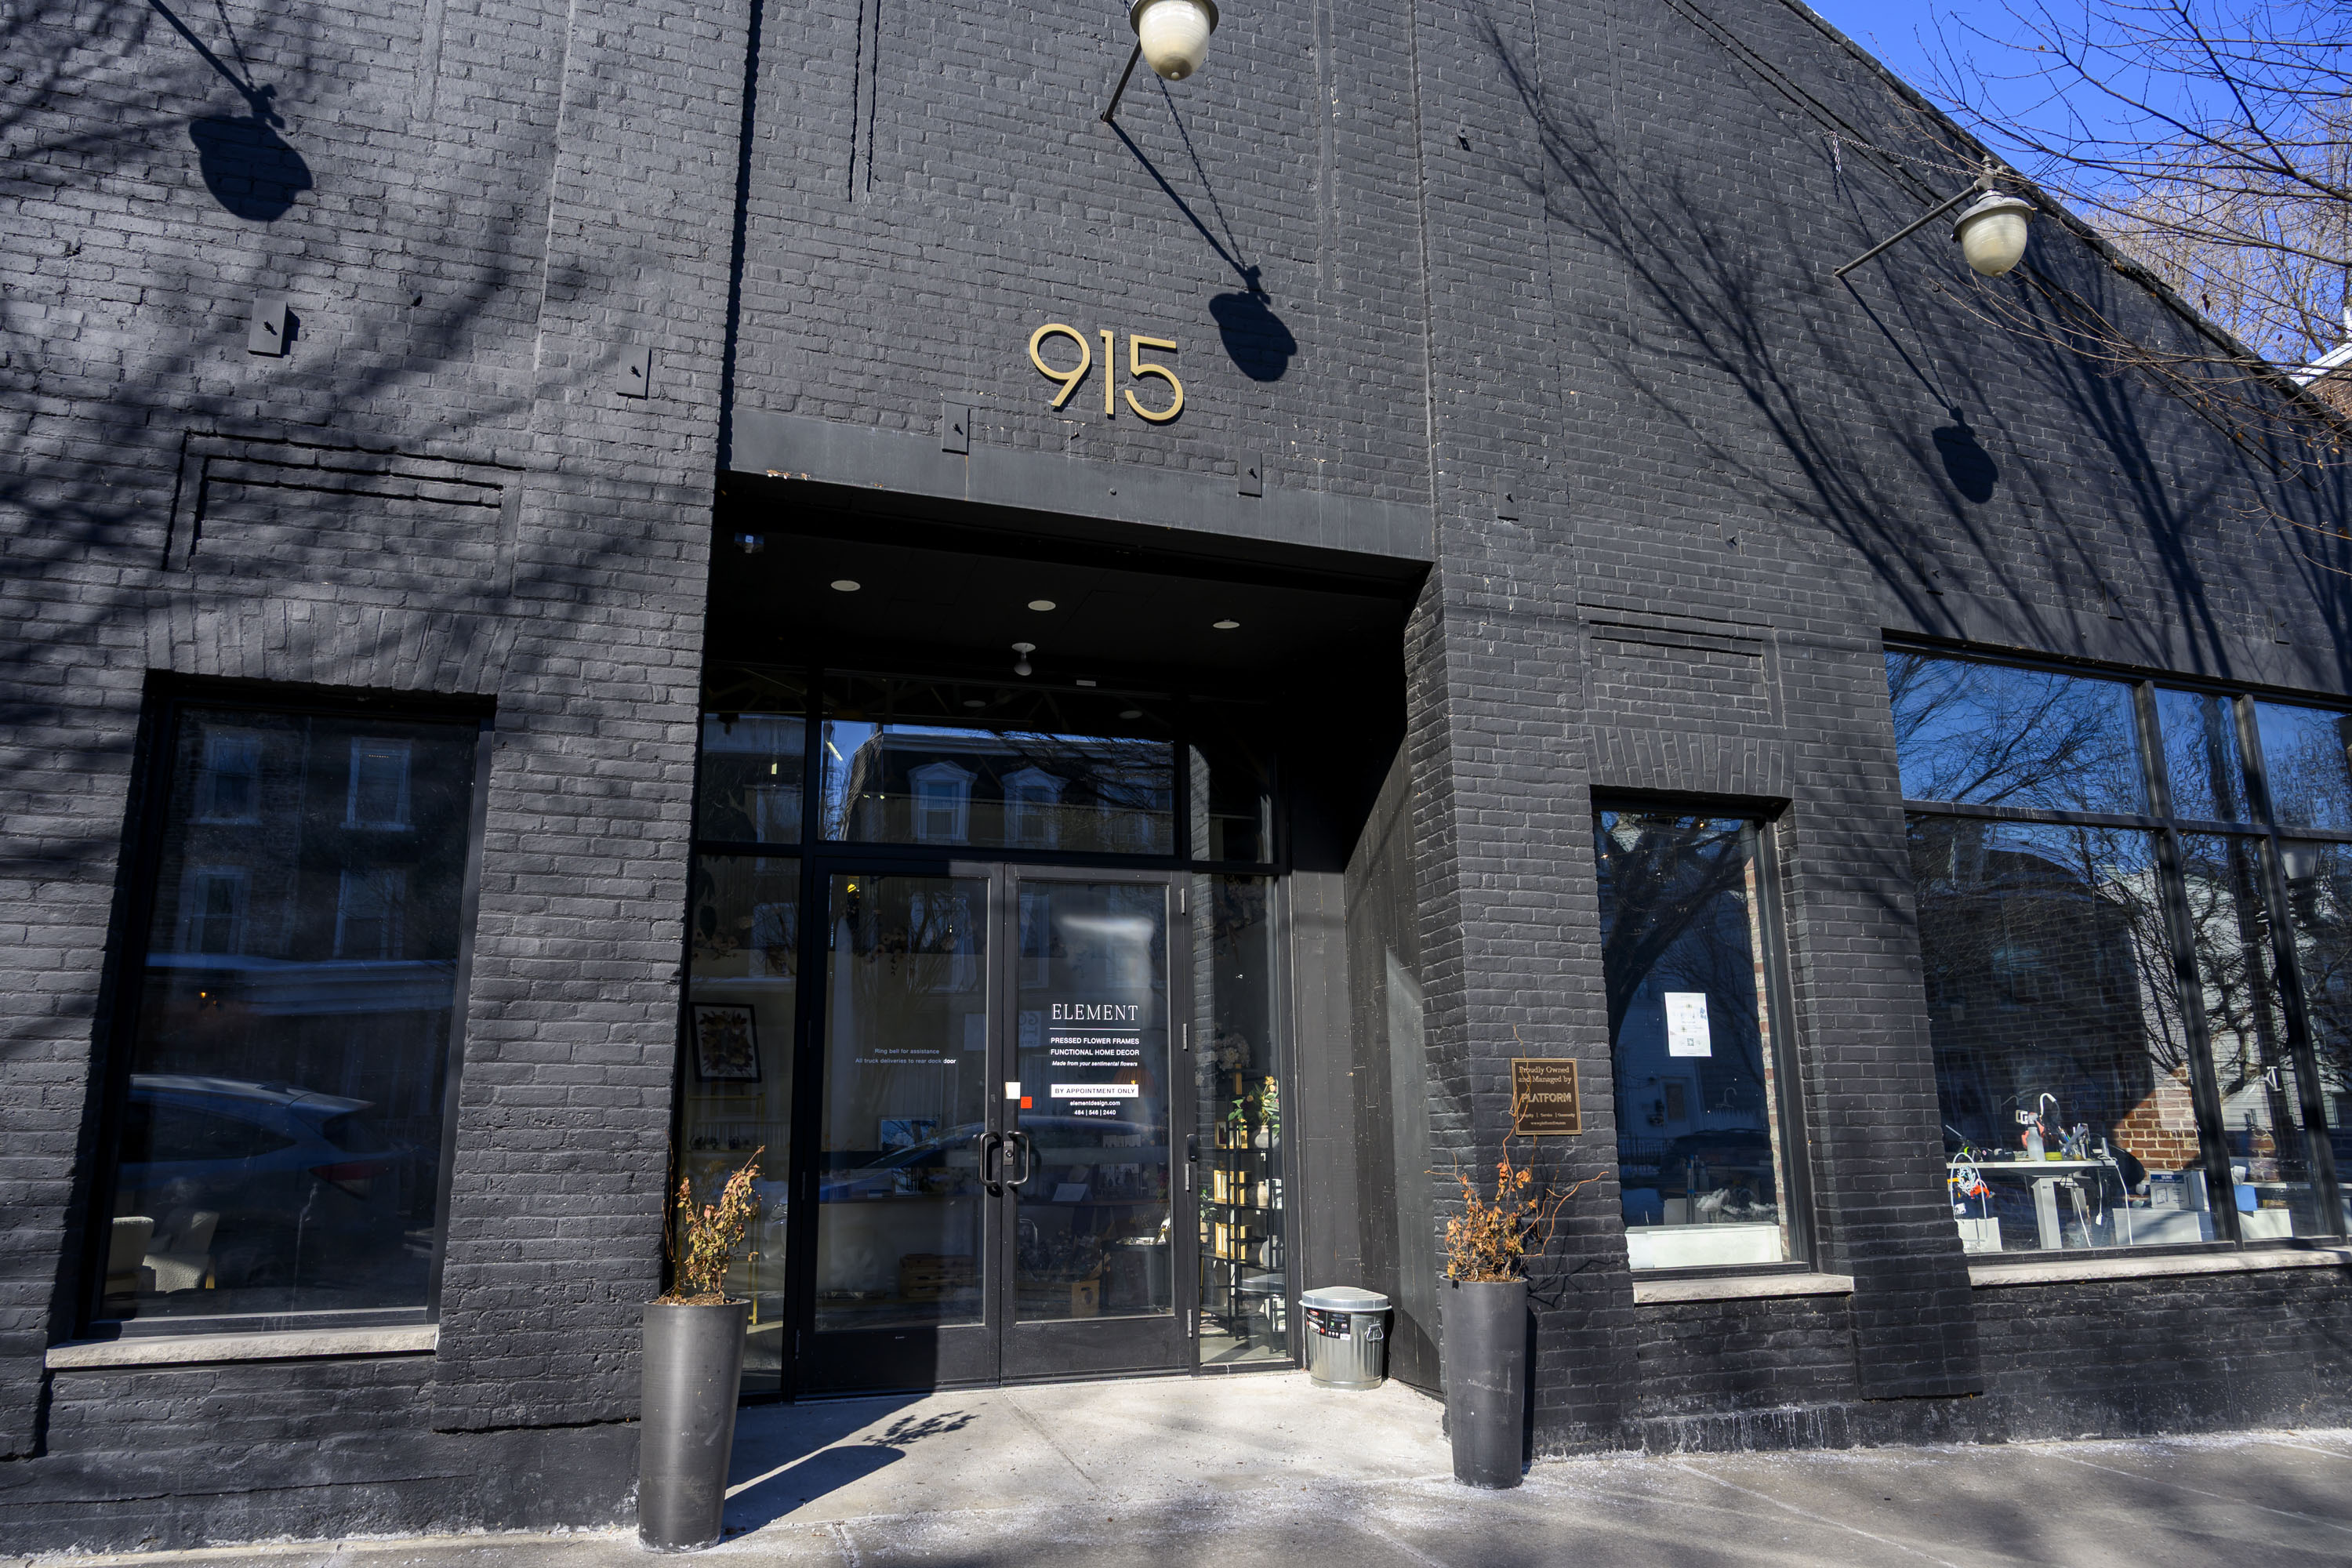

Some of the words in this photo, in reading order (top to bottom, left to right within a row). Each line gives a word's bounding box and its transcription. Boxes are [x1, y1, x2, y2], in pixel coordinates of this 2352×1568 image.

[1029, 323, 1184, 421] 915
[1052, 1004, 1138, 1021] ELEMENT
[1519, 1066, 1544, 1075] Proudly
[1532, 1076, 1562, 1084] Managed
[1563, 1076, 1572, 1084] by
[1521, 1092, 1573, 1102] PLATFORM
